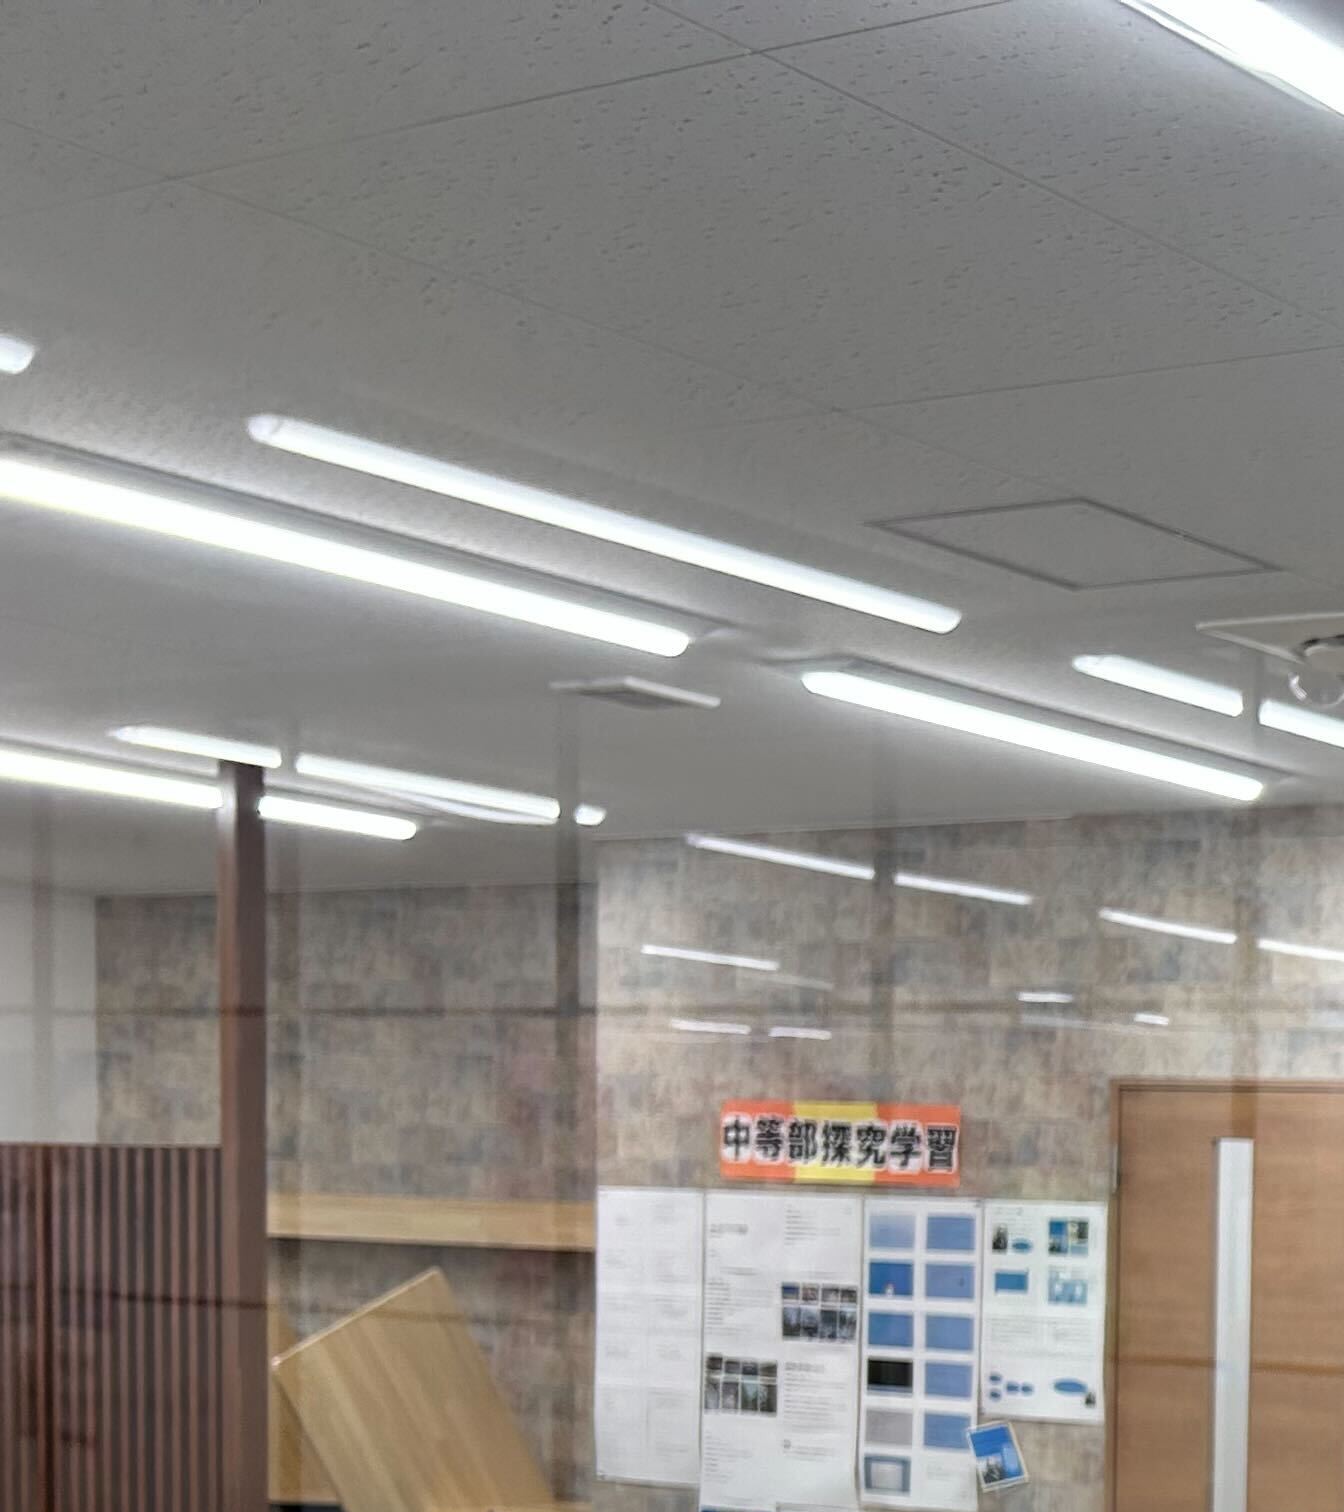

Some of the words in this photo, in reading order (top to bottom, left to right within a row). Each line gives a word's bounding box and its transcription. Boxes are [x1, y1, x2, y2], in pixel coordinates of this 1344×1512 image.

[723, 1114, 957, 1172] 中等部探究学習
